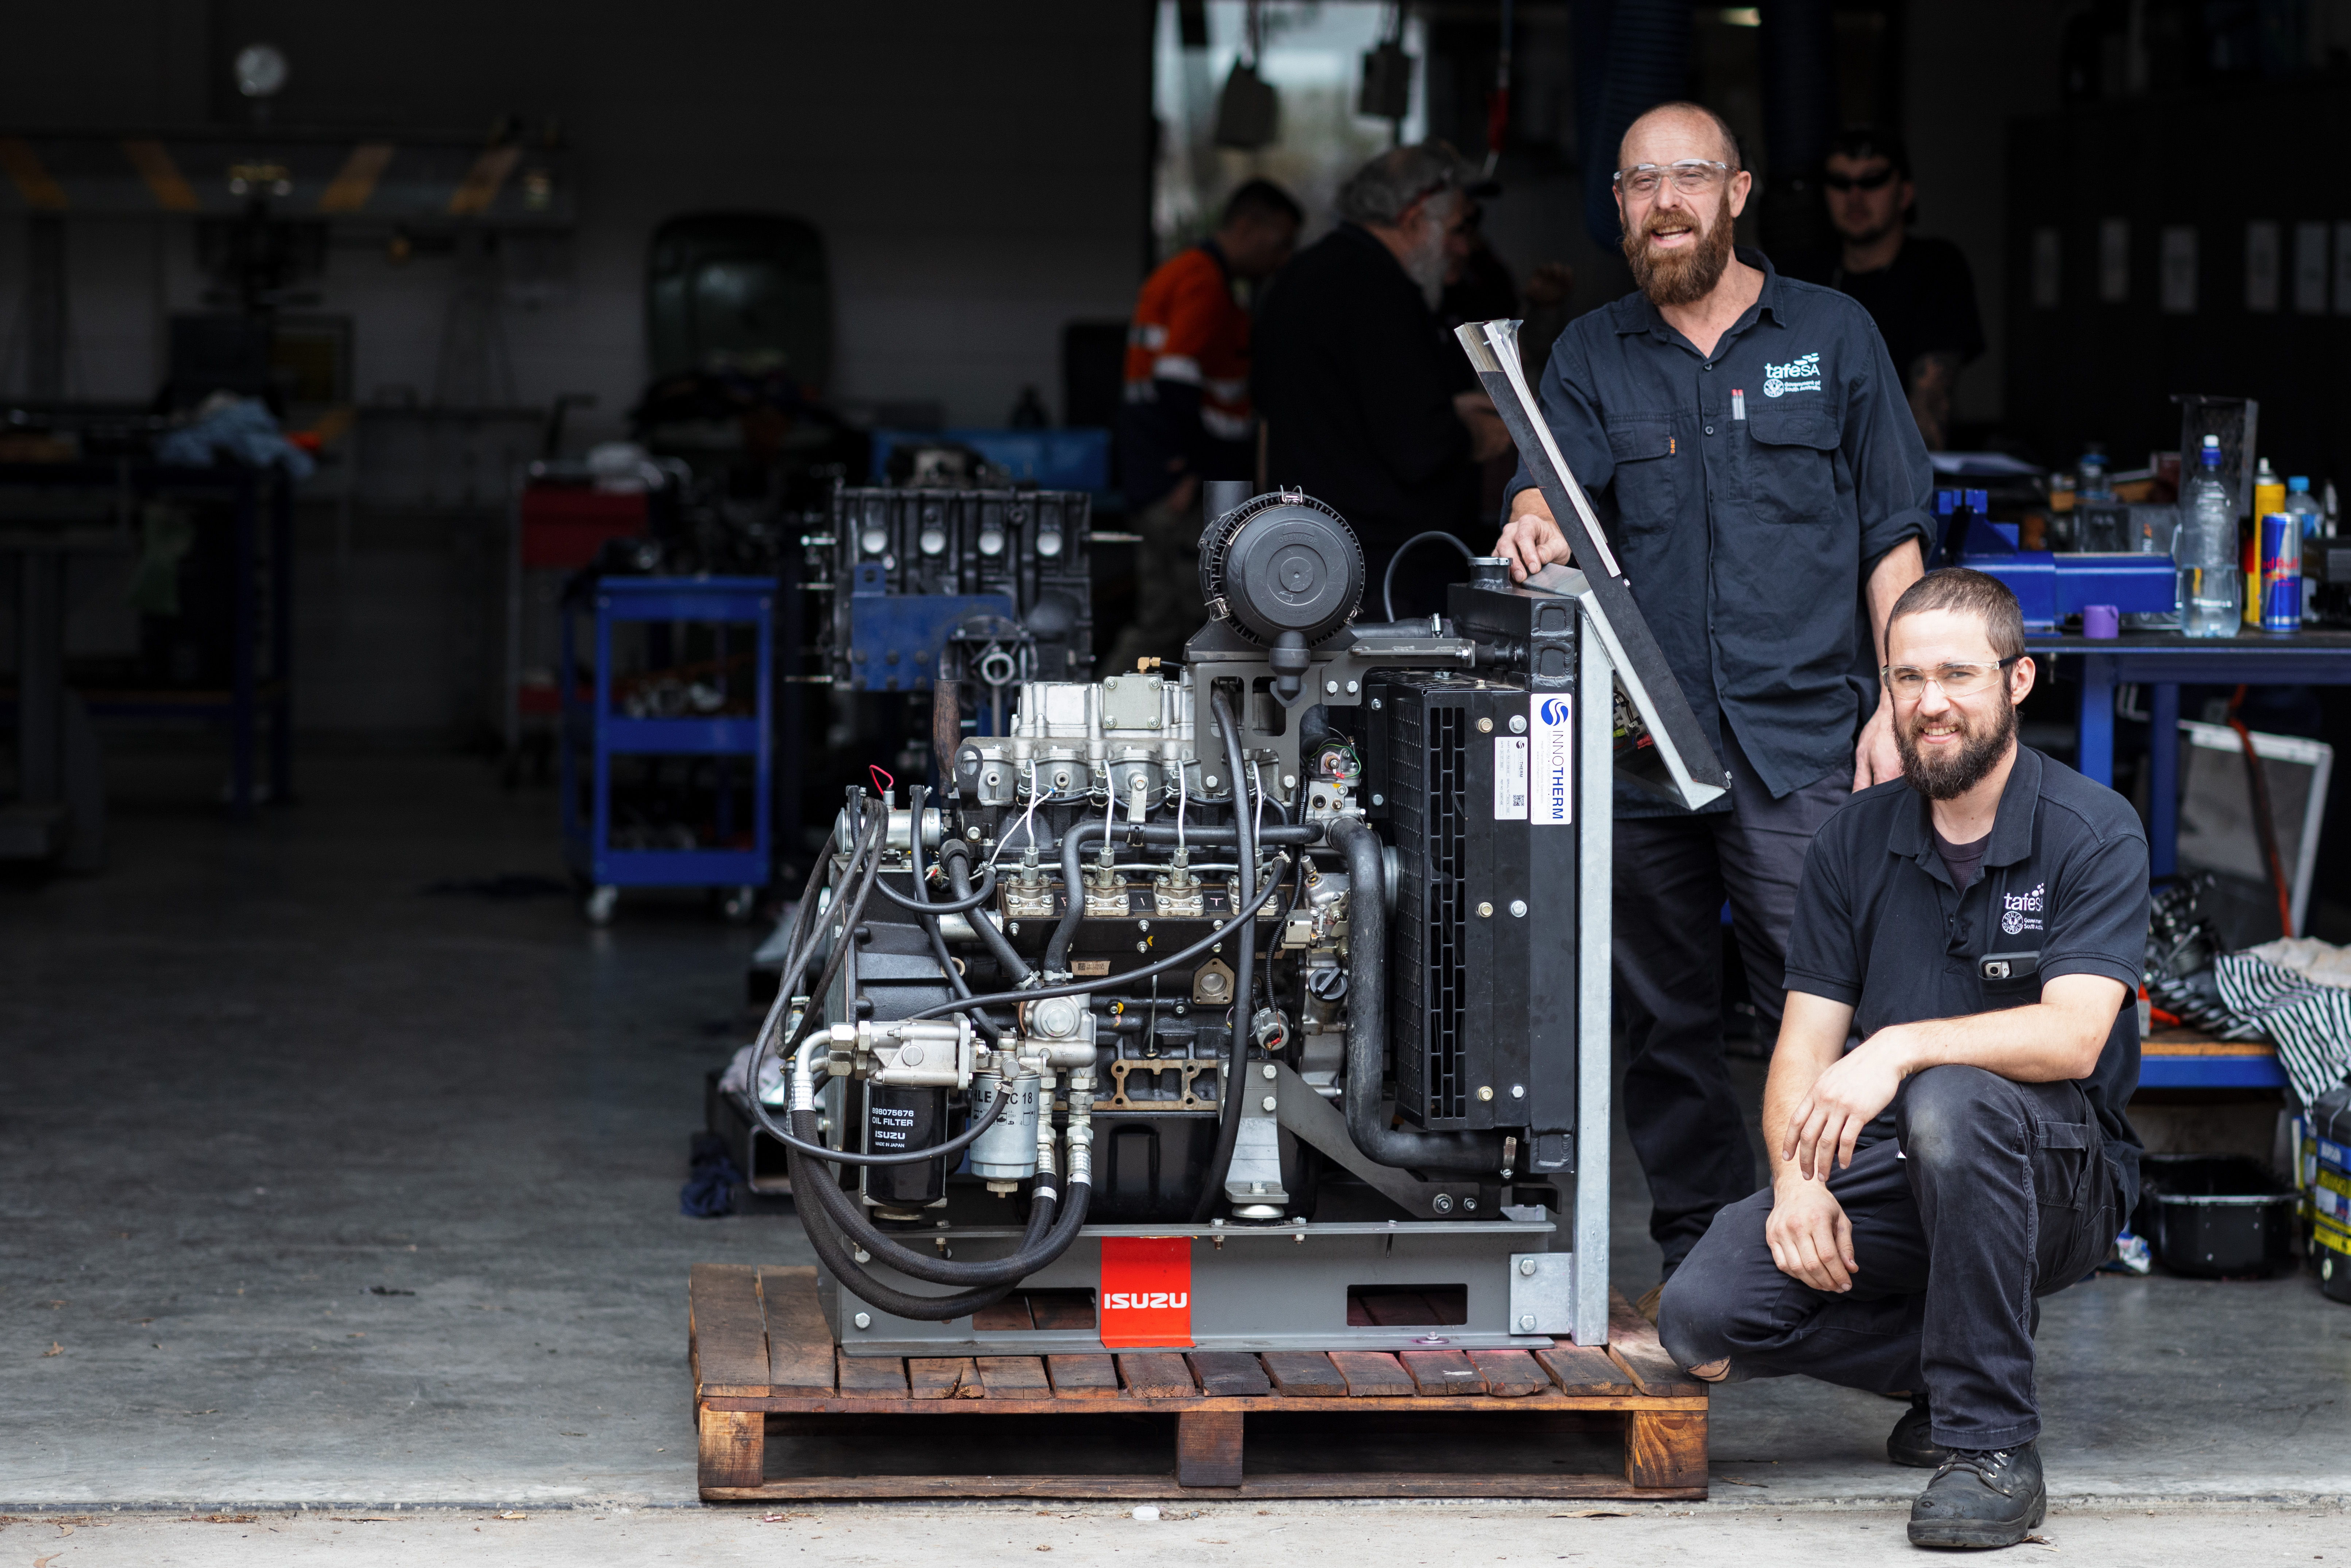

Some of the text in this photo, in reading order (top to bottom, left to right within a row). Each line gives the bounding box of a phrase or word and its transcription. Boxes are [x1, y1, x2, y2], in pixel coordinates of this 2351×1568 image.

[1764, 363, 1821, 379] tafeSA
[1552, 731, 1564, 819] INNOTHERM
[2004, 892, 2043, 911] tafeSA
[1023, 1092, 1032, 1104] 18
[872, 1107, 914, 1117] 898075676
[872, 1116, 913, 1127] OIL FILTER
[875, 1130, 905, 1140] ISUZU
[1104, 1292, 1187, 1309] ISUZU
